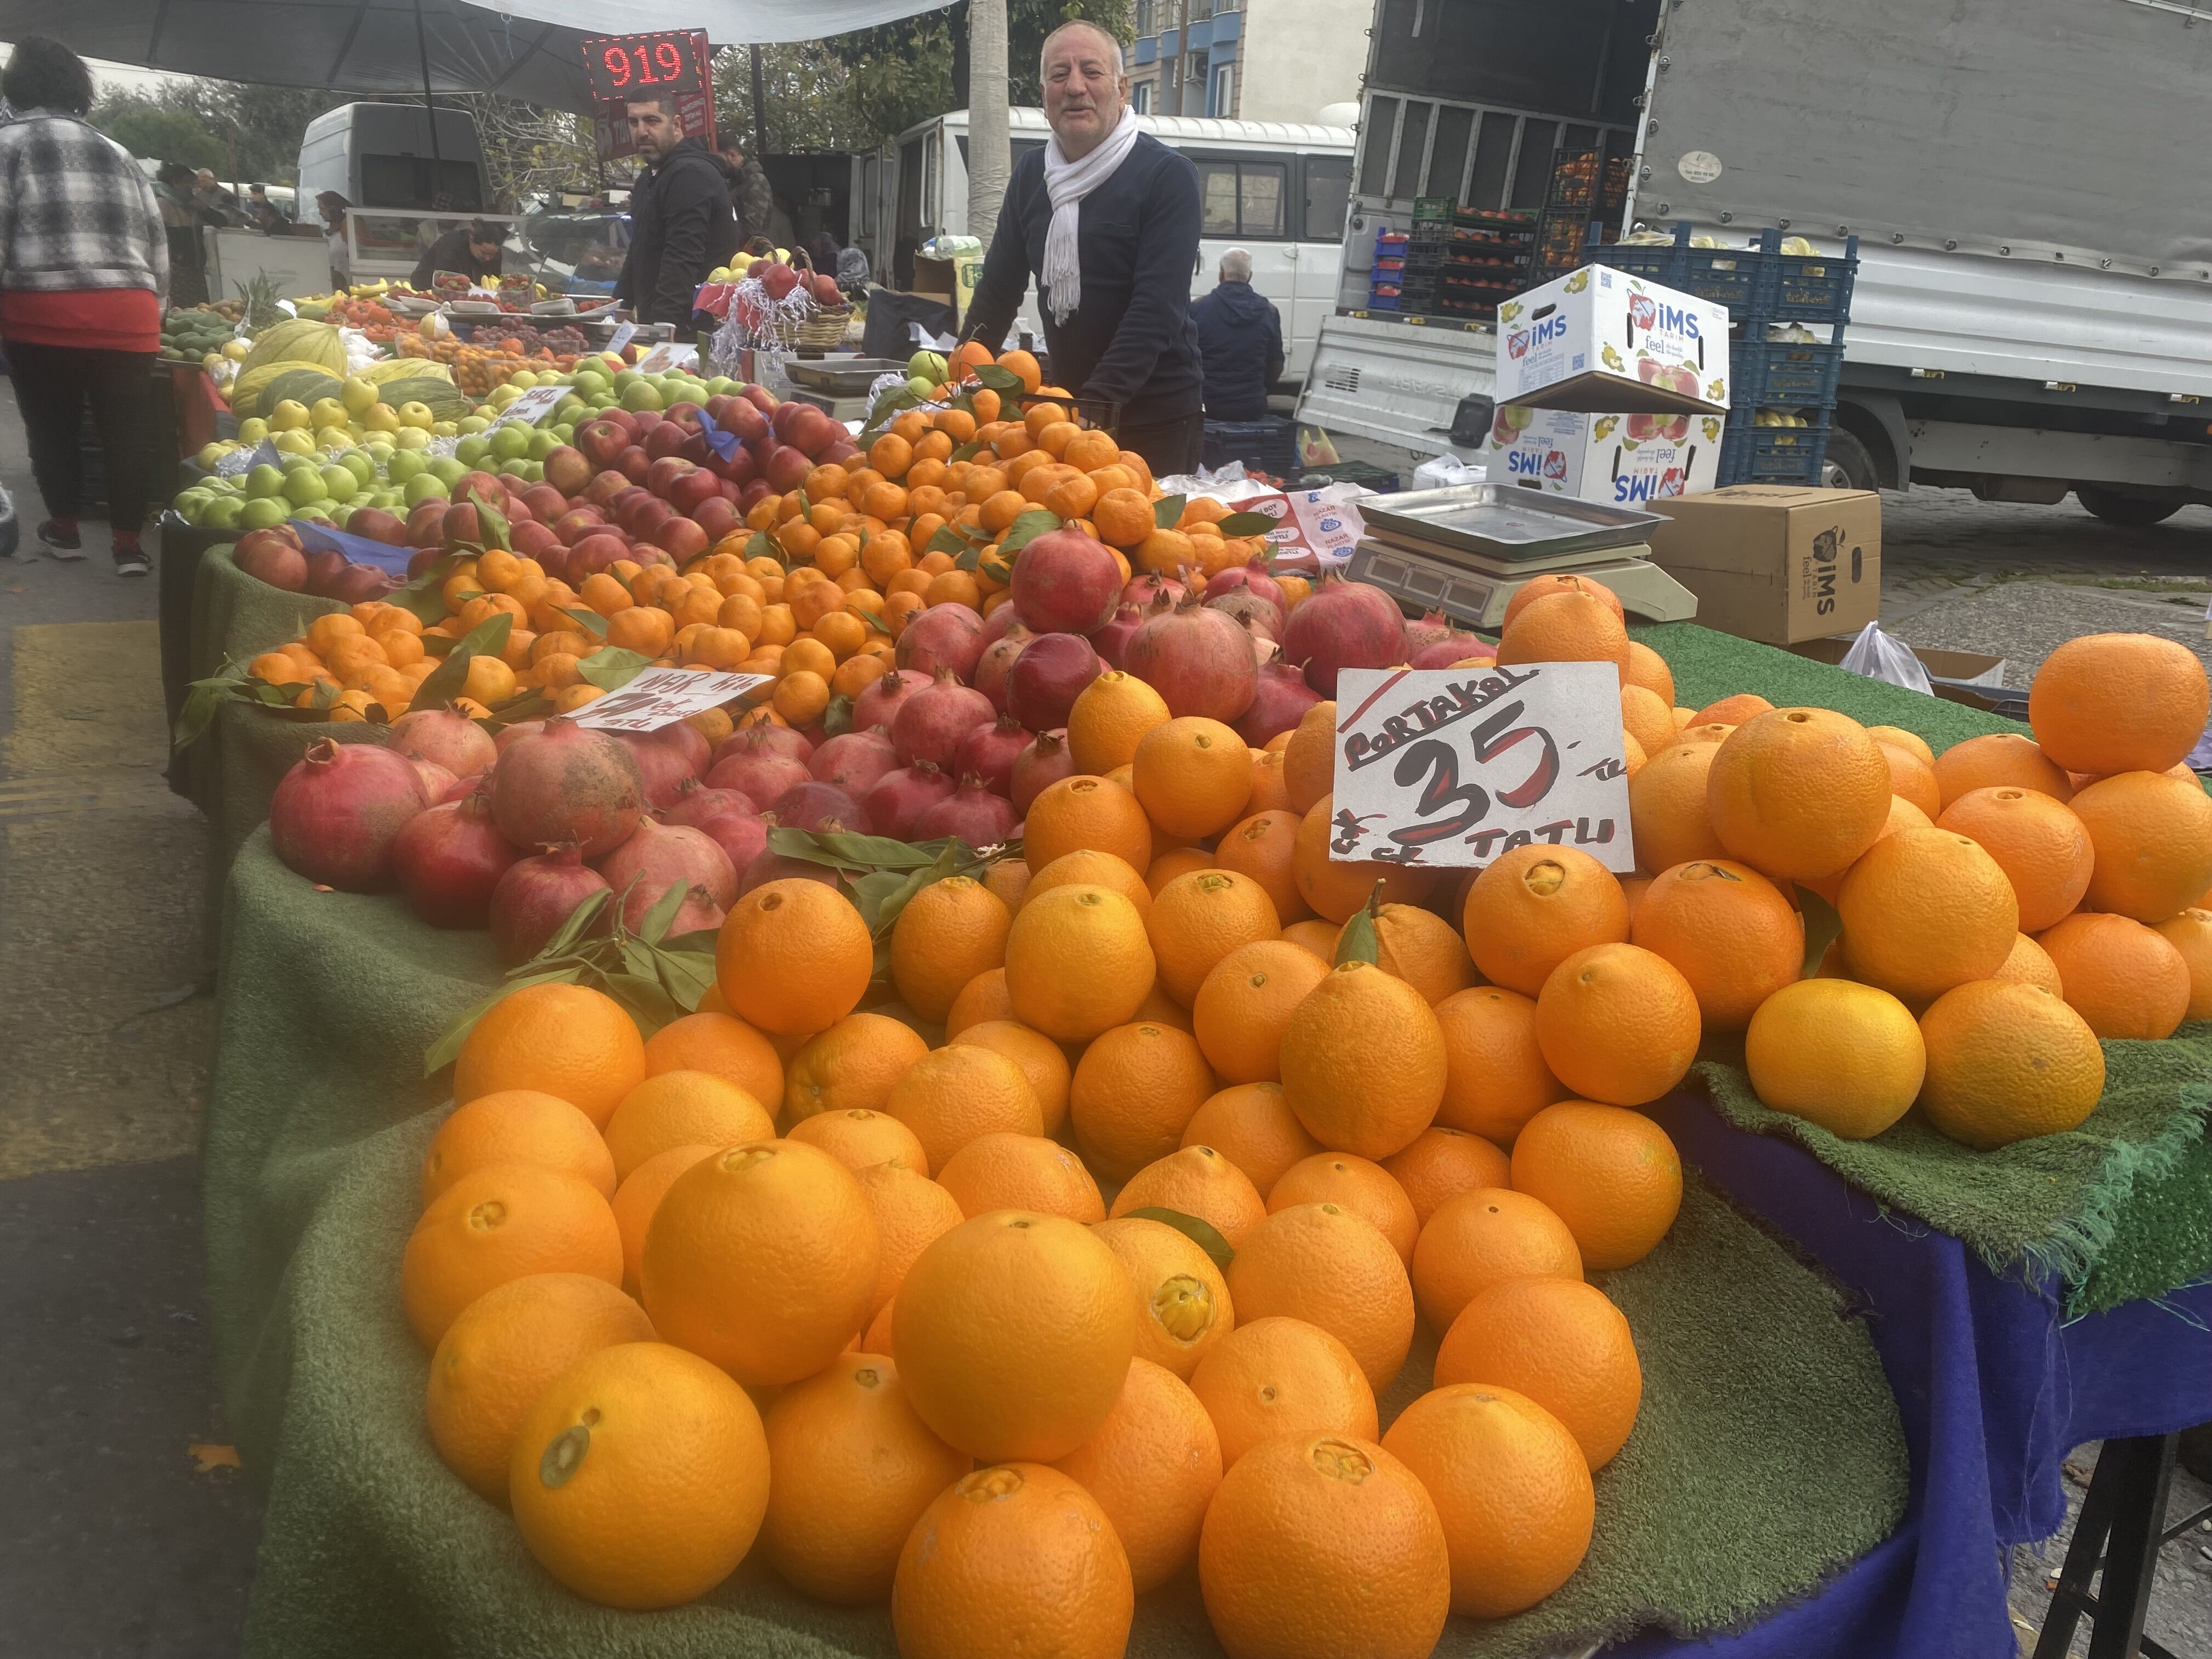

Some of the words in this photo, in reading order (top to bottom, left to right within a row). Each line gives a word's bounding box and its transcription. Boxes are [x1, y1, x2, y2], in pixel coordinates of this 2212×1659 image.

[604, 42, 681, 86] 919
[1660, 329, 1684, 342] TARIM
[1645, 335, 1664, 354] feel
[1522, 353, 1537, 367] feel
[1538, 437, 1554, 448] feel
[1656, 449, 1677, 463] feel
[1263, 503, 1277, 513] BOY
[1313, 505, 1336, 517] NAZAR
[1325, 533, 1348, 545] NAZAR
[1803, 556, 1812, 578] feel
[634, 673, 711, 694] NAR
